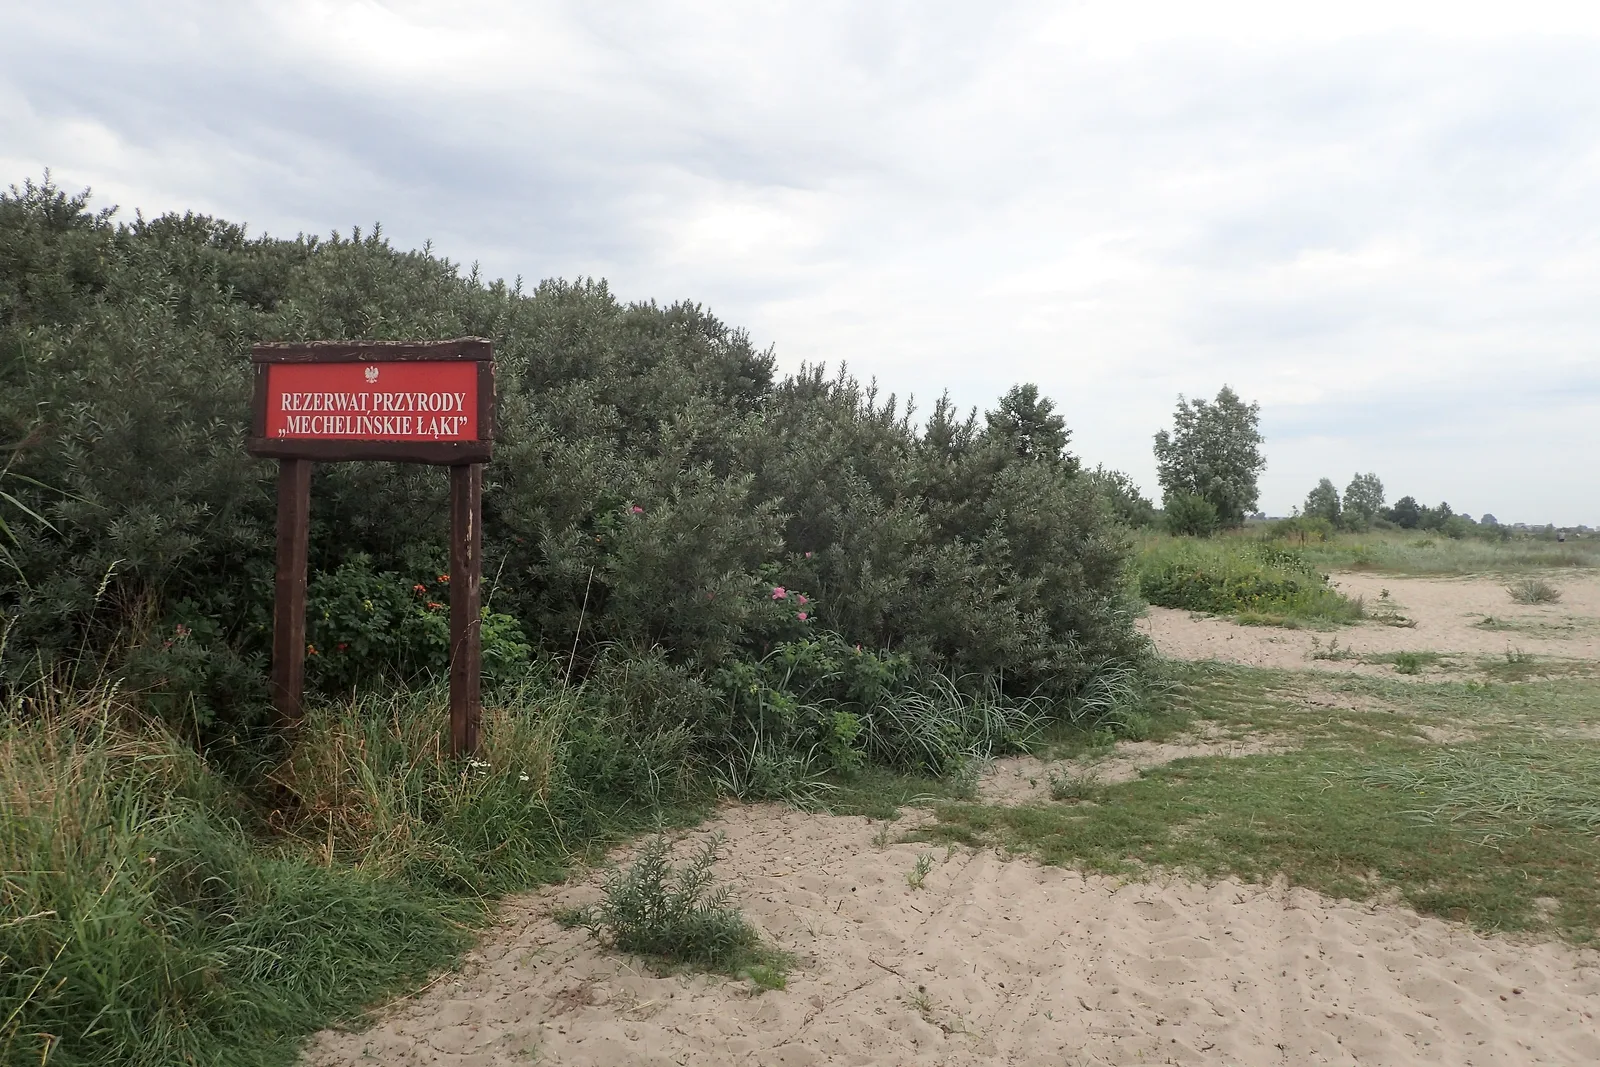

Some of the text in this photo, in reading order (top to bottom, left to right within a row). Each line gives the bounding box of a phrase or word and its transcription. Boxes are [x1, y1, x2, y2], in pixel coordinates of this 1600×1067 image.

[281, 392, 466, 412] REZERWAT PRZYRODY
[278, 410, 468, 439] „MECHELIŃSKIE ŁĄKI”
